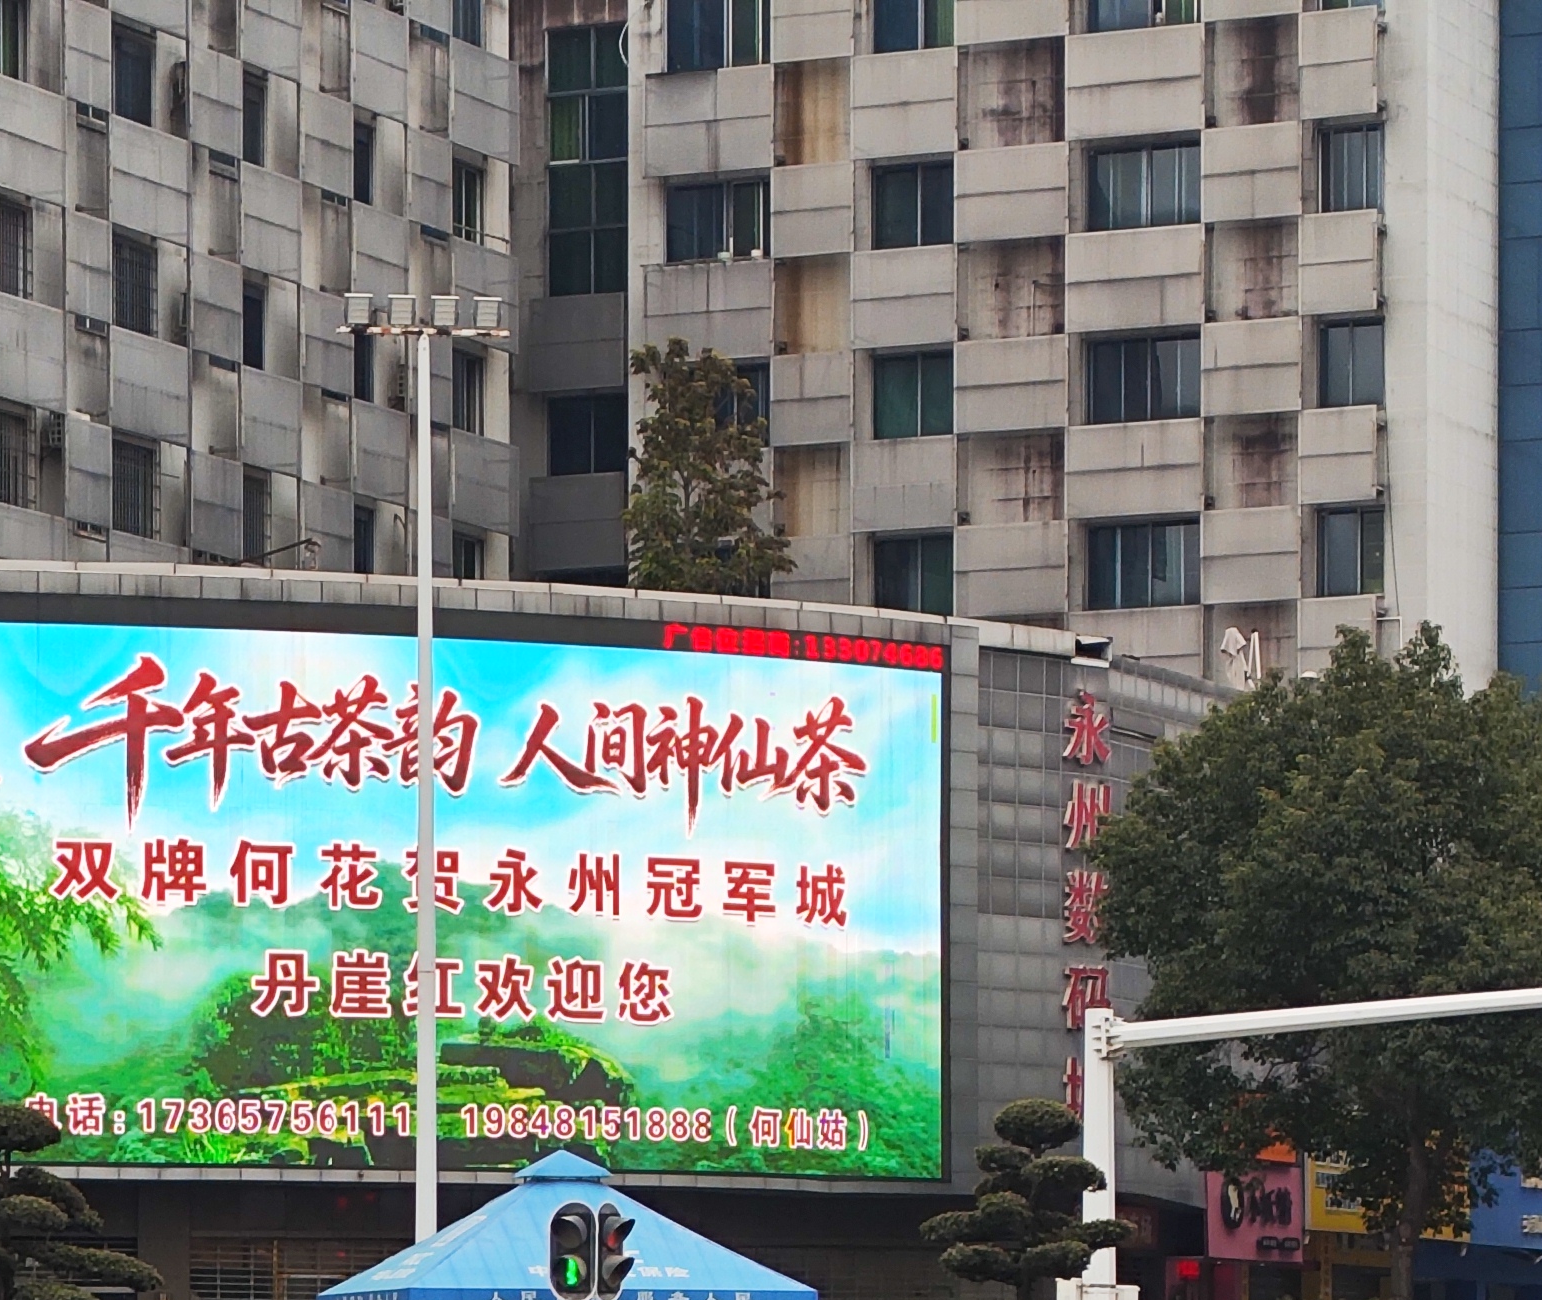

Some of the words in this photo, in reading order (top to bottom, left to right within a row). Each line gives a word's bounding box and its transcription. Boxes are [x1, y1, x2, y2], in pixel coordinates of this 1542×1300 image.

[24, 654, 478, 831] 千年古茶韵
[501, 692, 867, 837] 人间神仙茶
[51, 838, 850, 928] 双牌何花贺永州冠军城
[252, 950, 674, 1024] 丹崖红欢迎您
